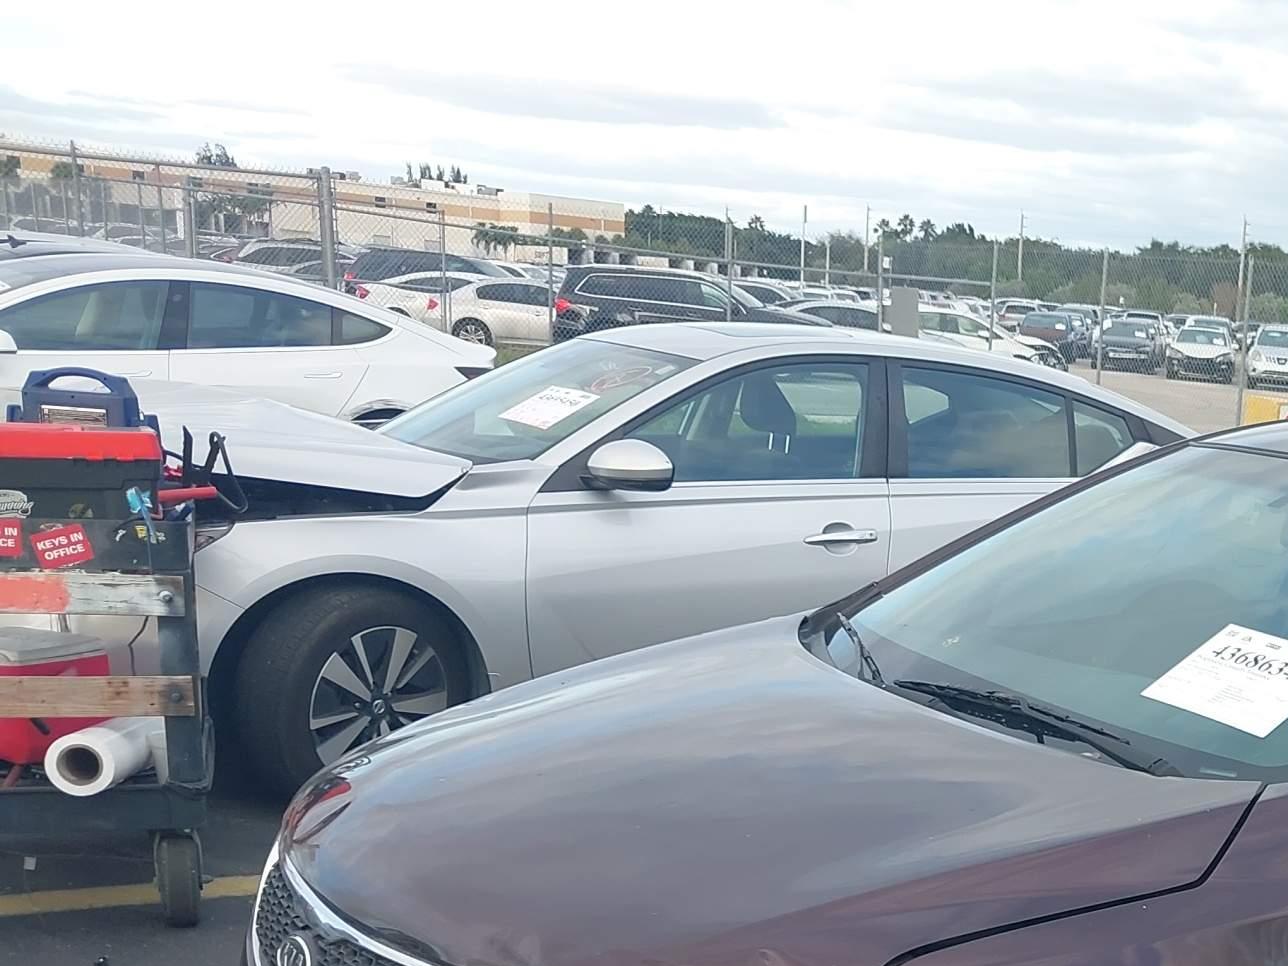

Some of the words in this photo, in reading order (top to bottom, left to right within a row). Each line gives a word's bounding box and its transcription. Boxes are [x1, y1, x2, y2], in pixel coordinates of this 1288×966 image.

[36, 536, 68, 551] KEYS
[69, 531, 84, 543] IN
[44, 543, 86, 561] OFFICE
